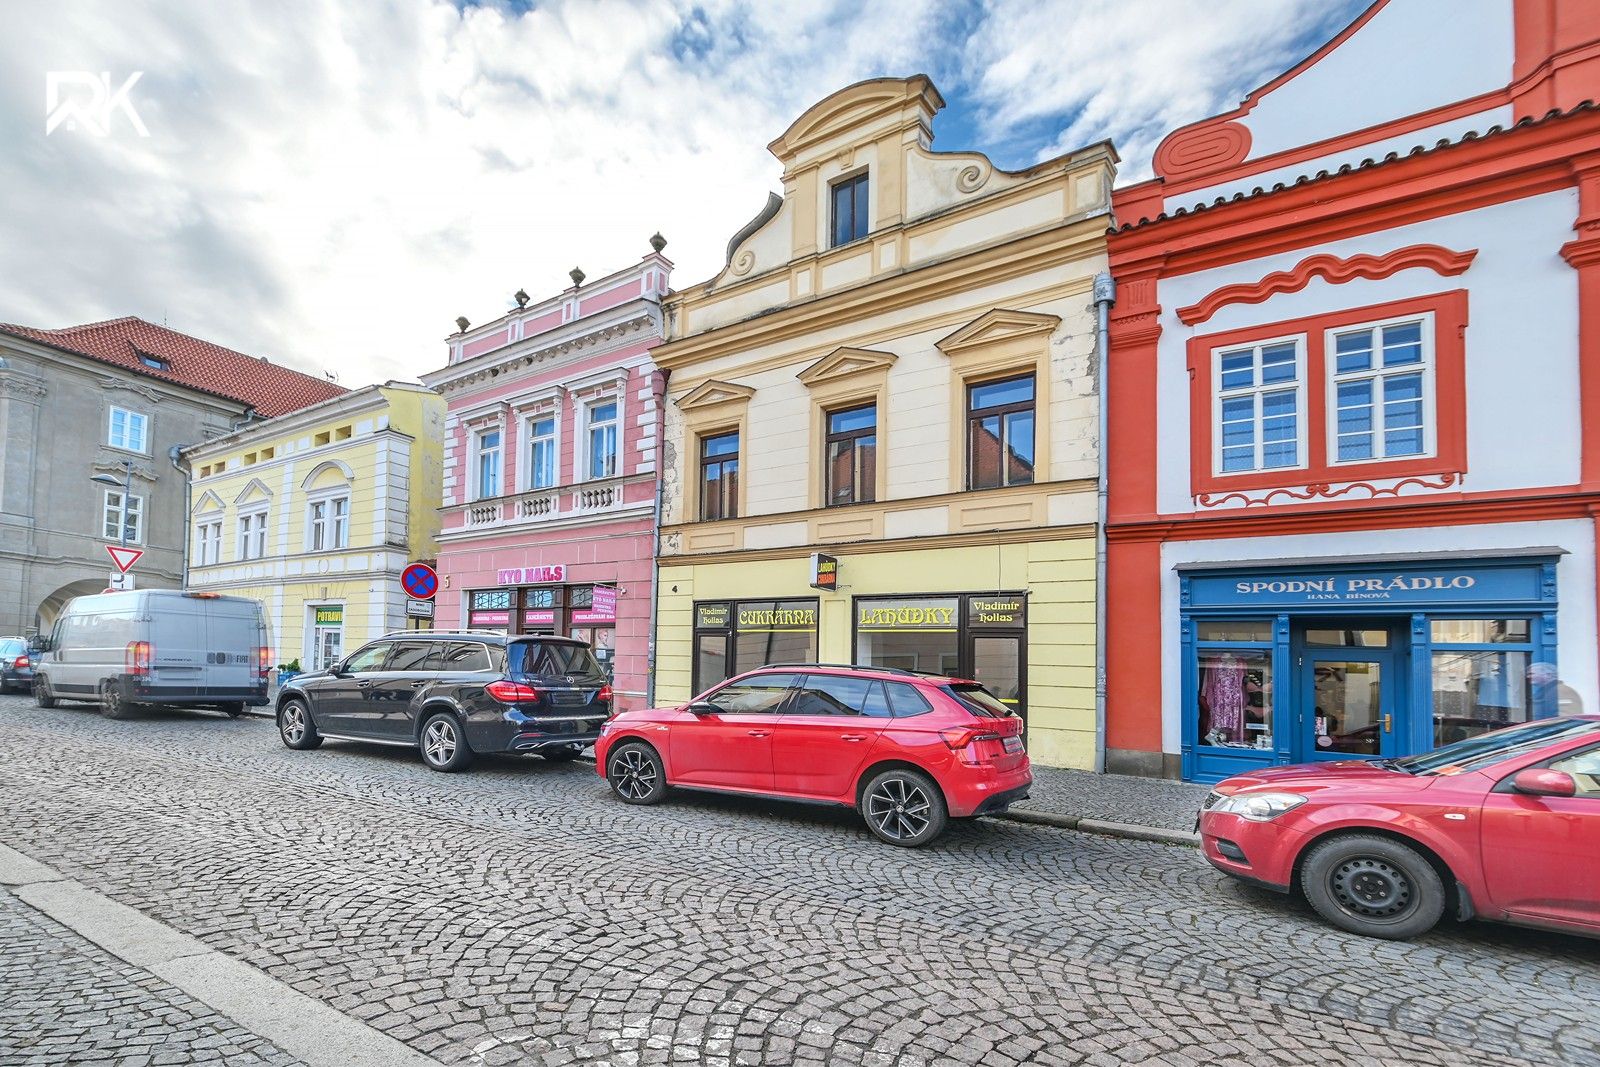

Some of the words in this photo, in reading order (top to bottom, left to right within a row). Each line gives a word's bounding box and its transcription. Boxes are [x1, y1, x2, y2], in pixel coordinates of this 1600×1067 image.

[444, 575, 451, 588] 5
[498, 569, 522, 584] KYO
[525, 566, 563, 582] NAILS
[671, 585, 678, 594] 4
[1236, 577, 1335, 594] SPODNÍ
[1347, 575, 1476, 592] PRÁDLO
[973, 601, 1020, 611] Vladimír
[739, 607, 815, 625] CUKRÁRNA
[236, 655, 249, 663] FIAT
